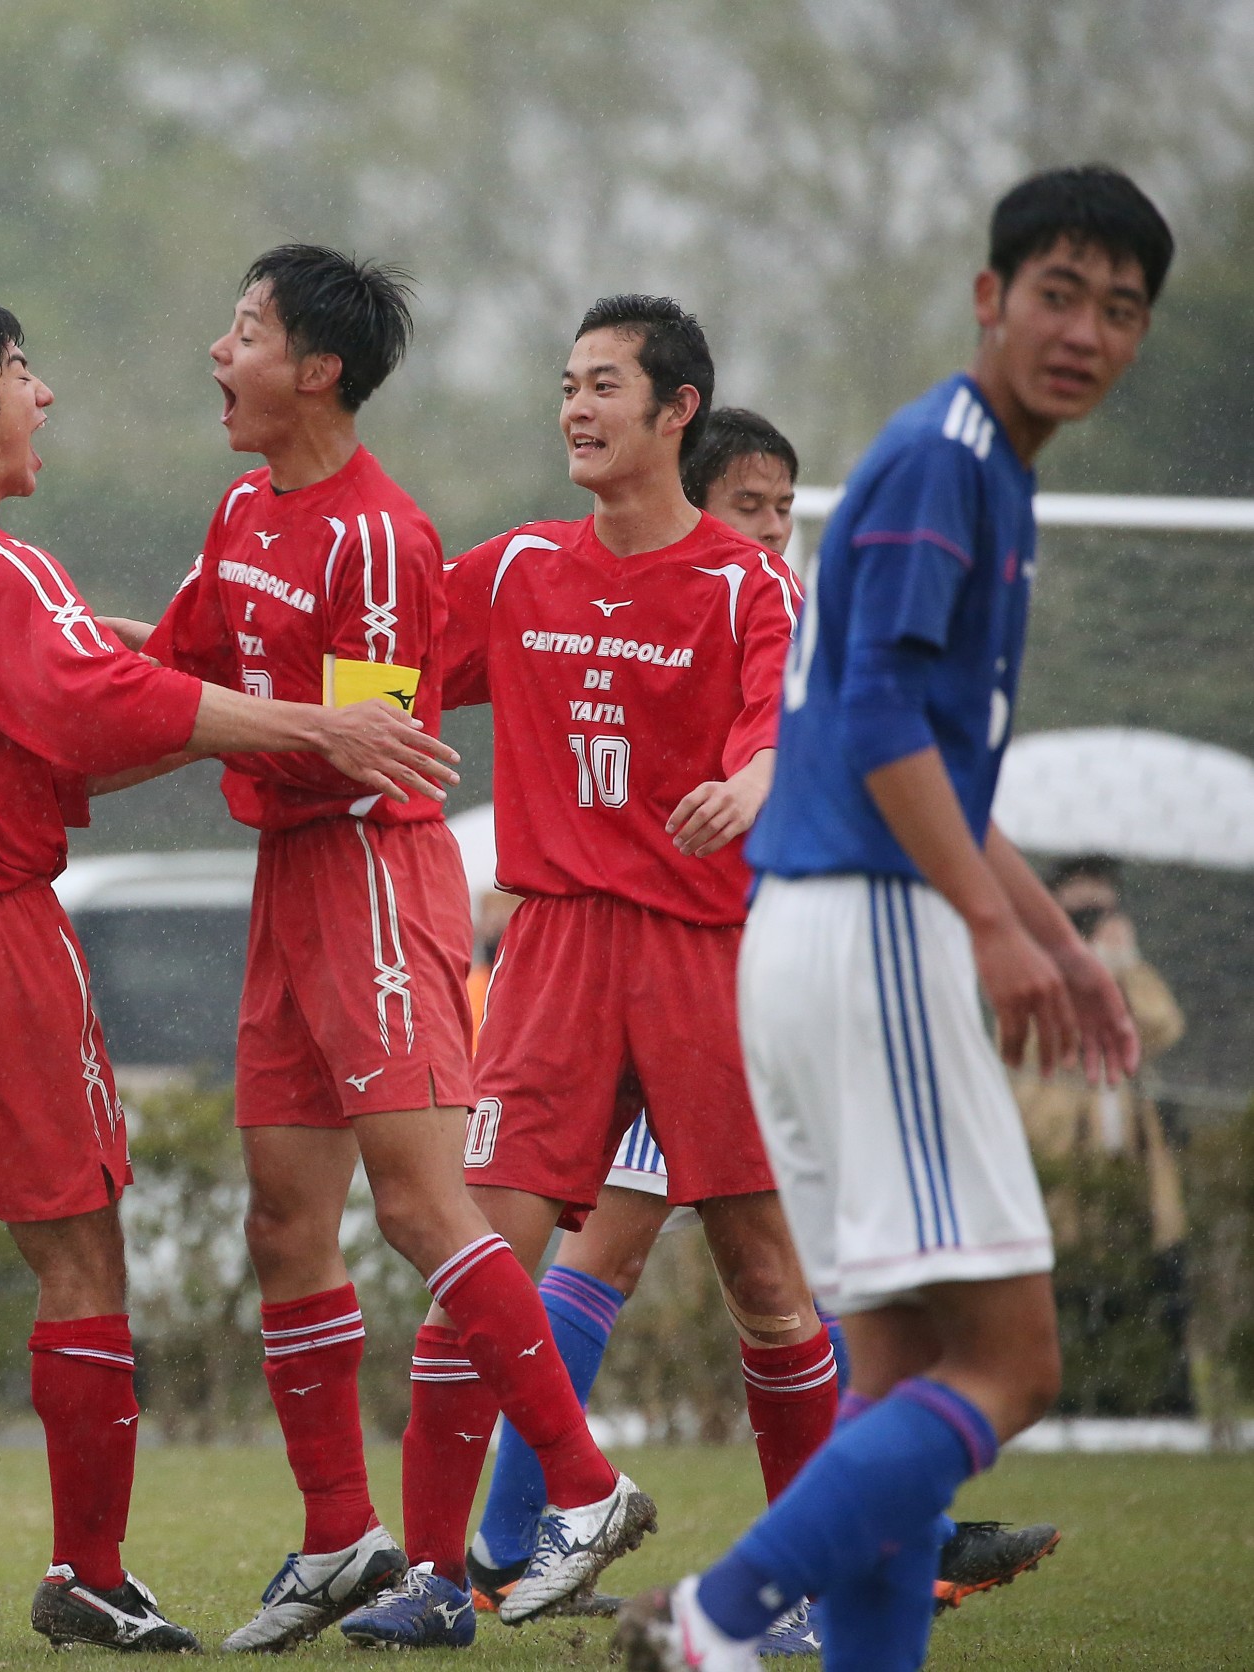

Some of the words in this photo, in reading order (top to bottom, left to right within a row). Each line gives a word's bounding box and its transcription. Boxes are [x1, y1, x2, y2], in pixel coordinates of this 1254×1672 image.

[245, 565, 316, 614] ESCOLAR
[521, 629, 594, 655] CENTRO
[596, 636, 694, 668] ESCOLAR
[583, 668, 614, 691] DE
[568, 700, 626, 726] YAITA
[568, 734, 631, 809] 10
